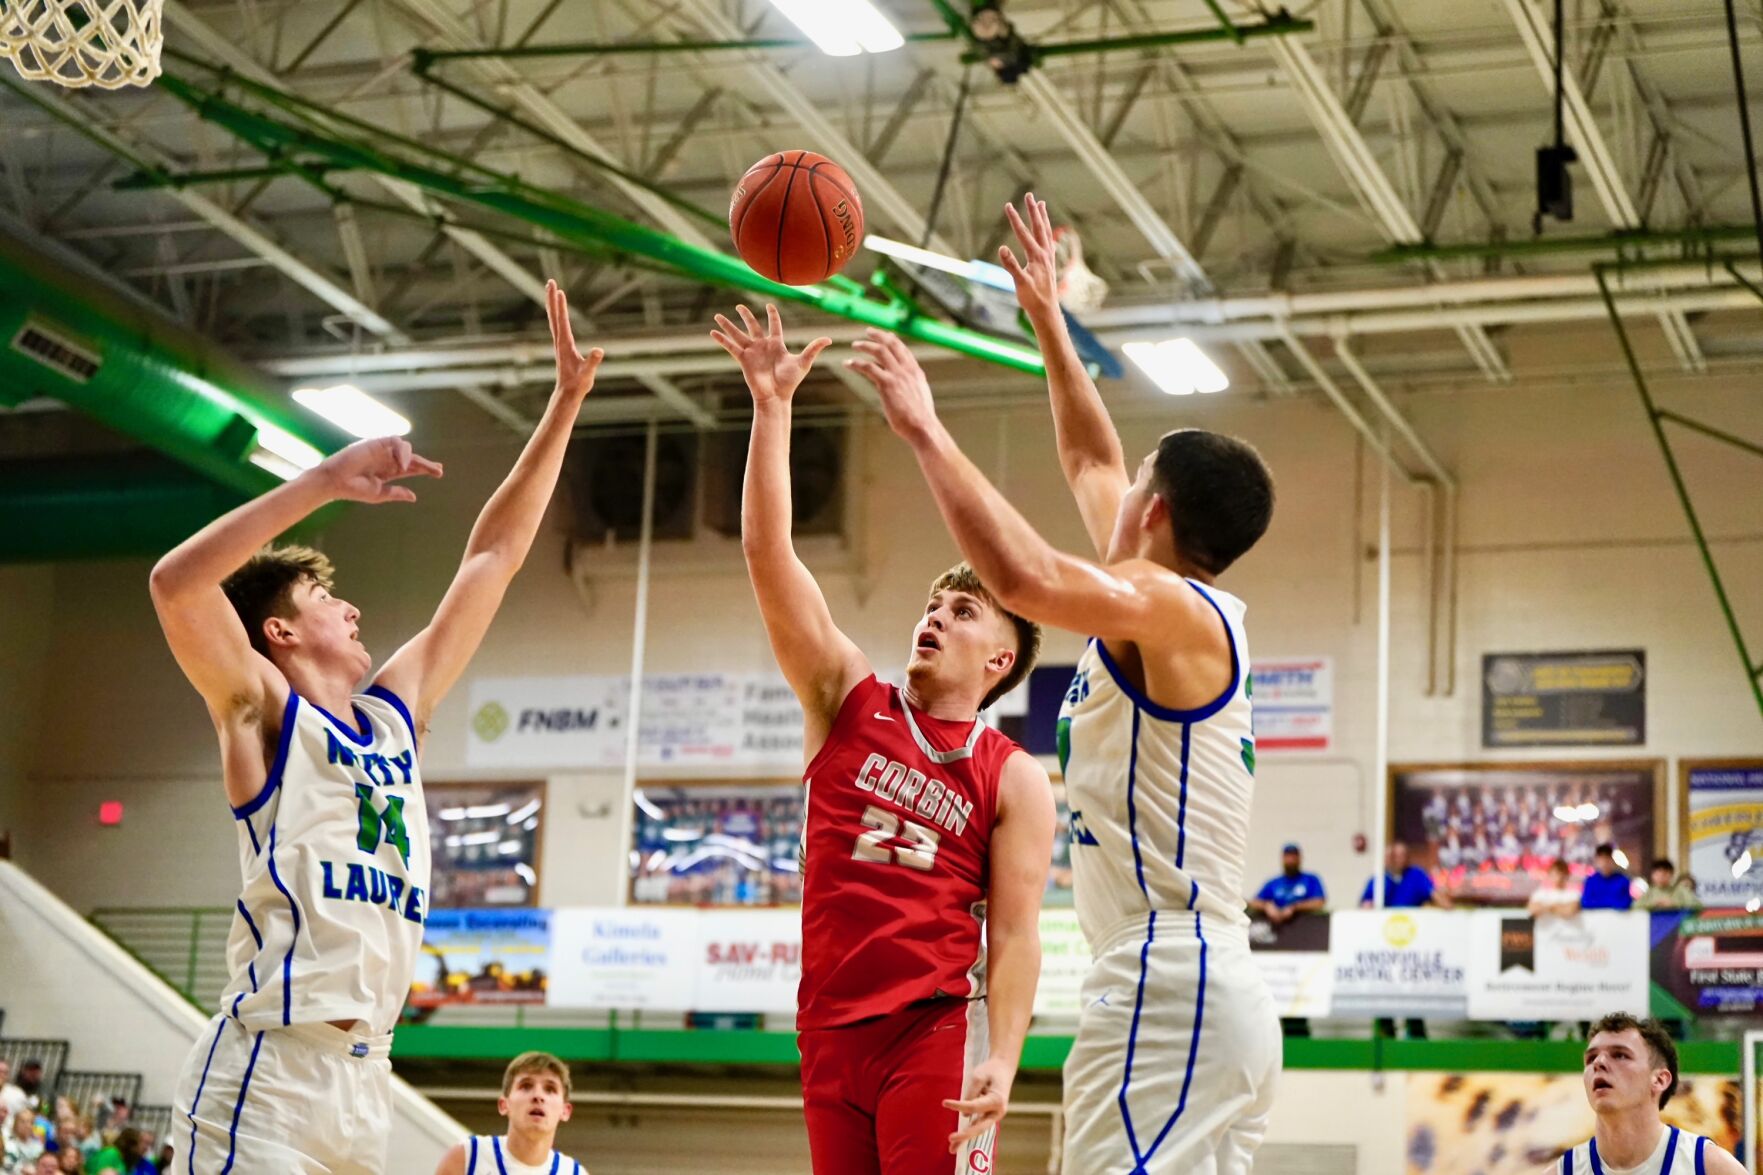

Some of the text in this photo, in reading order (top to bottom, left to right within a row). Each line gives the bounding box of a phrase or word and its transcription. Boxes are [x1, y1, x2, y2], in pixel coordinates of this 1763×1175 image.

[517, 707, 599, 734] FNBM
[855, 752, 974, 837] CORBIN
[355, 782, 411, 871] 14
[851, 804, 942, 872] 23
[319, 860, 428, 930] LAURE
[1334, 965, 1465, 984] DENTAL CENTER
[1354, 951, 1443, 973] KNOXVILLE
[969, 1149, 989, 1174] C
